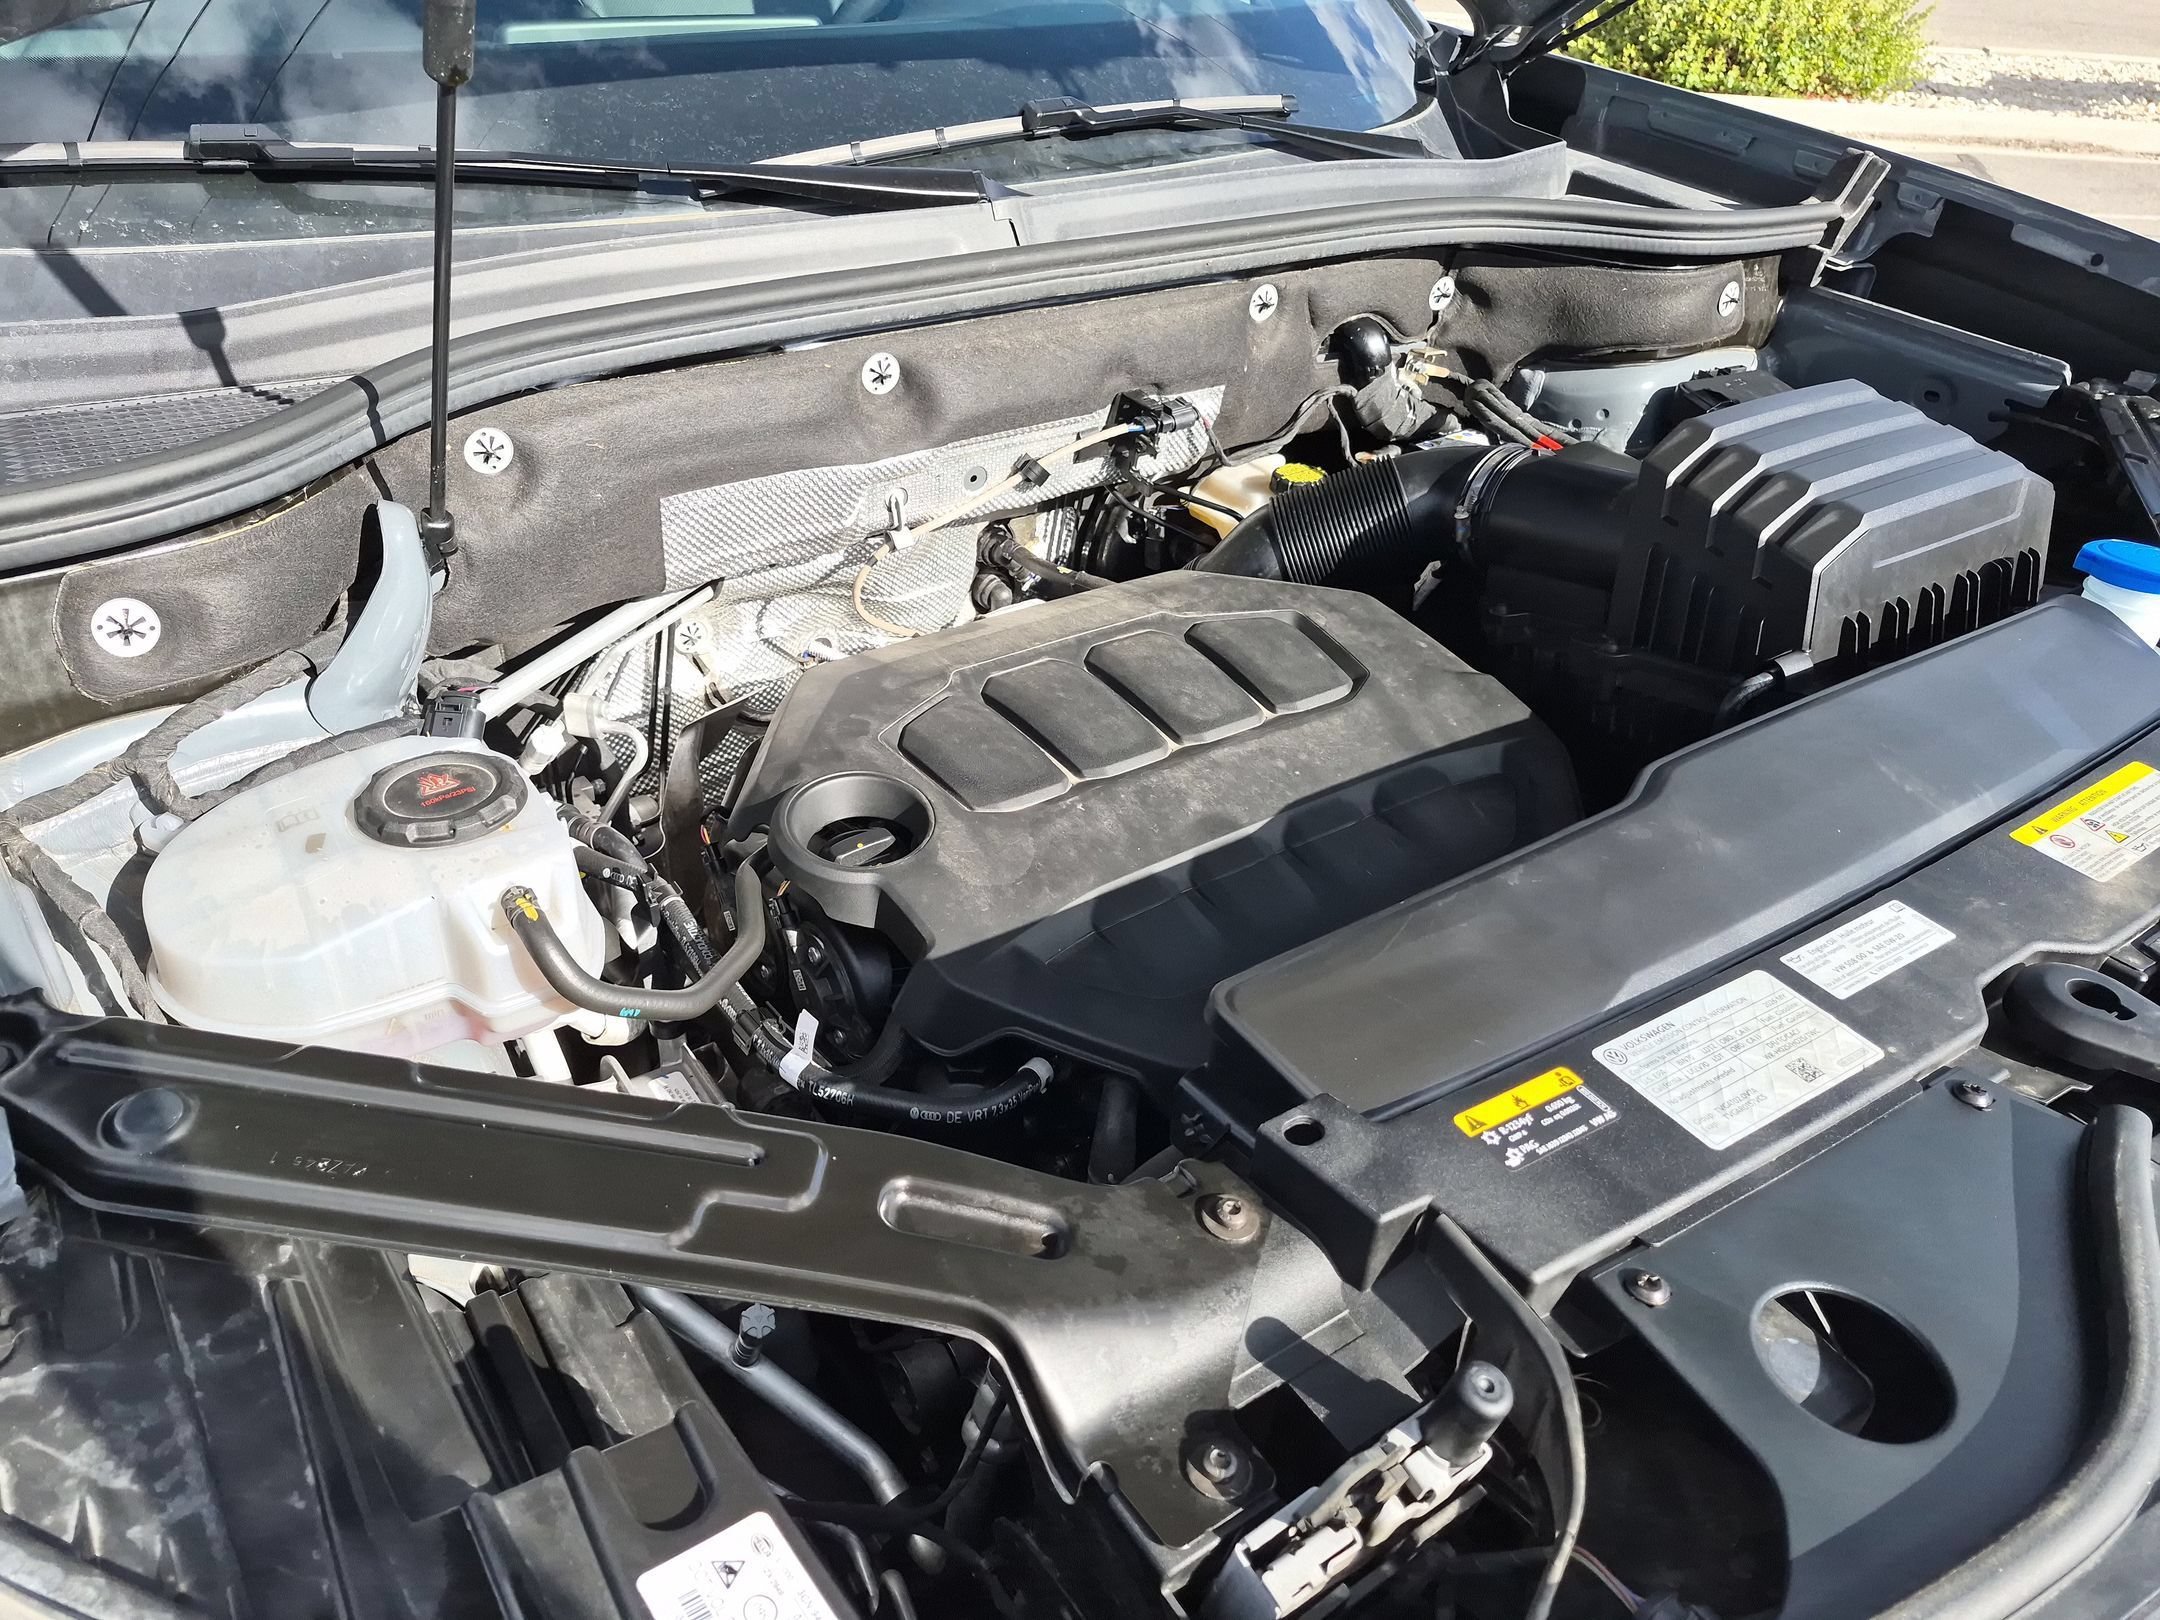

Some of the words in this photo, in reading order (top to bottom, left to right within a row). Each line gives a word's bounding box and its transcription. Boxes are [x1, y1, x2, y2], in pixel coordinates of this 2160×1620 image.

[2052, 806, 2078, 822] WARNING
[2078, 789, 2107, 807] ATTENTION
[1831, 964, 1847, 973] VW
[1854, 952, 1868, 960] 00
[1871, 942, 1886, 951] SAE
[1679, 1014, 1710, 1031] CONTROL
[1706, 995, 1747, 1018] INFORMATION
[1618, 1020, 1676, 1051] VOLKSWAGEN
[1710, 1066, 1736, 1082] needed
[807, 1079, 855, 1106] TL52706H
[946, 1110, 962, 1124] DE
[967, 1110, 989, 1123] VRT
[1497, 1112, 1534, 1136] R-1234yf
[1561, 1096, 1576, 1106] kg
[1588, 1114, 1607, 1127] VW
[1603, 1110, 1617, 1120] AG
[1518, 1139, 1540, 1154] PAG
